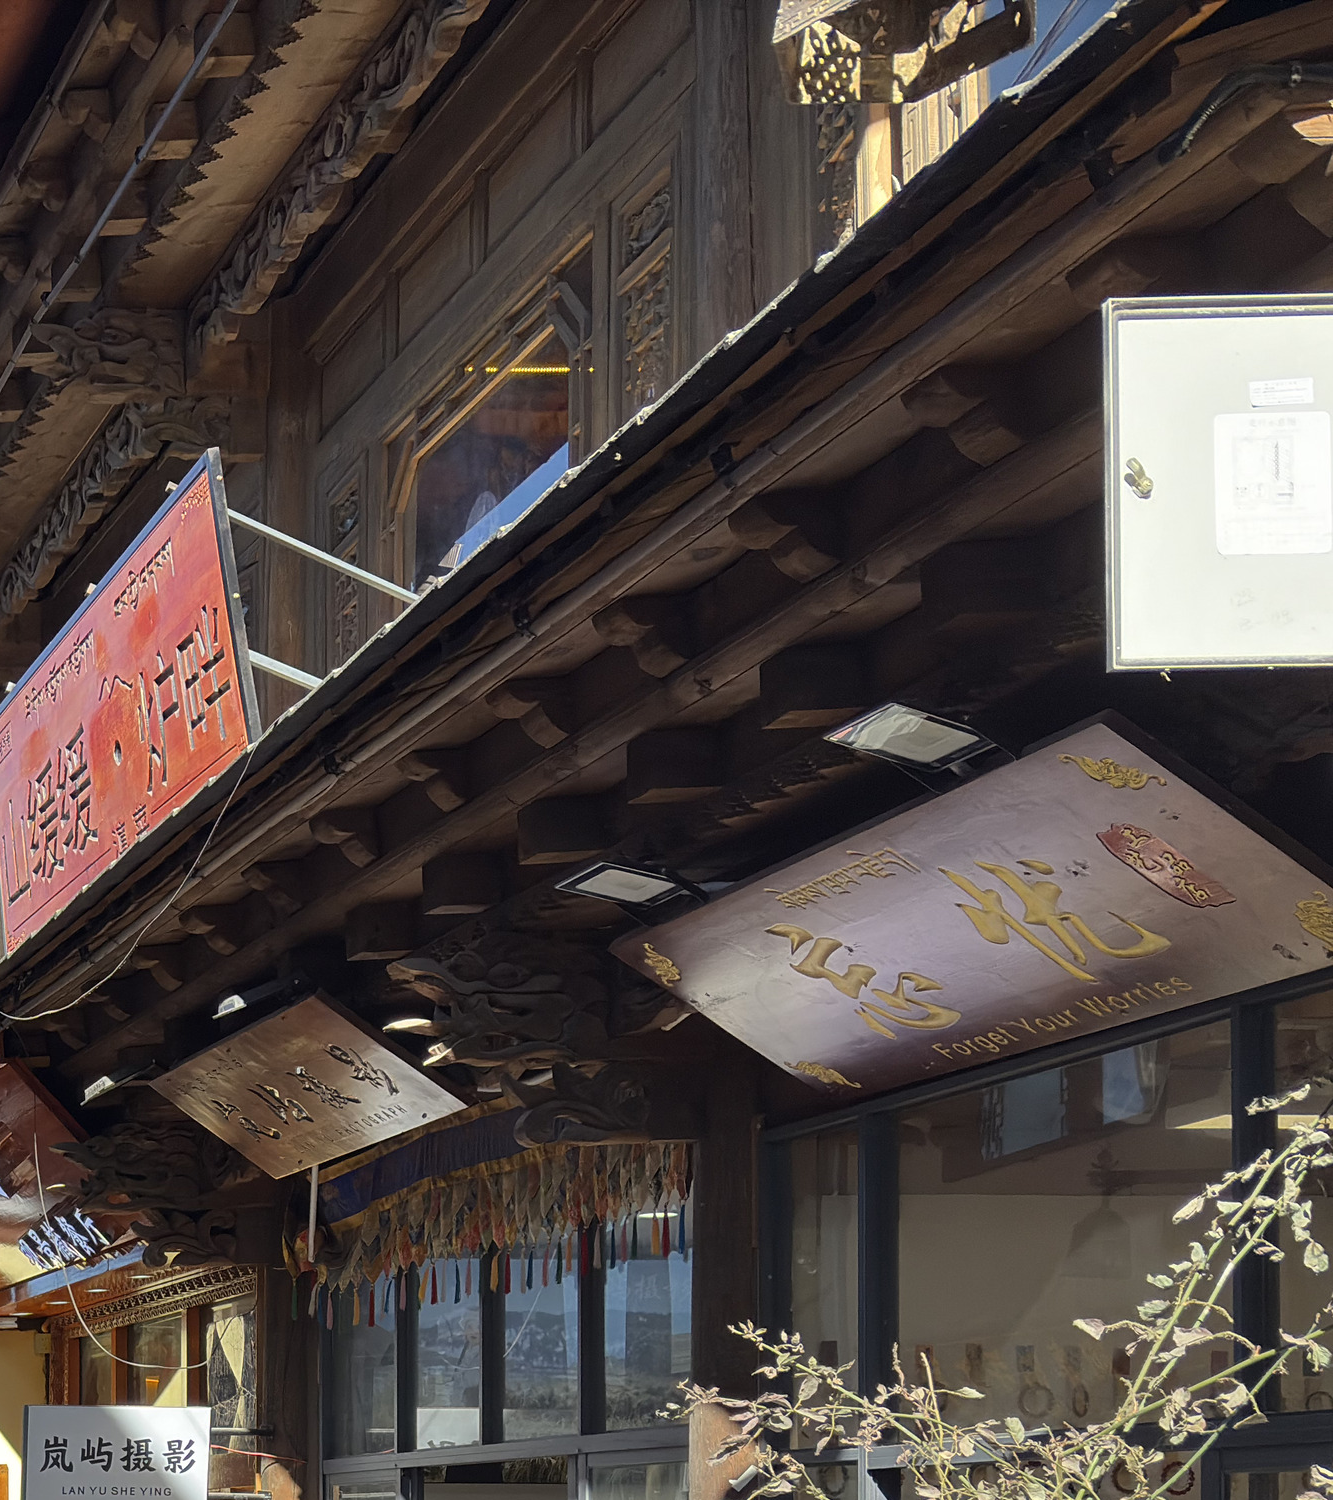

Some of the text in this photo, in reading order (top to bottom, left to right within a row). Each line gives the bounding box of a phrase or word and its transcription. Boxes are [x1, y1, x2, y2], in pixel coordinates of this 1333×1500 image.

[2, 604, 232, 906] 山缓缓 炉畔
[764, 858, 1173, 1040] 忘忧
[931, 973, 1194, 1061] Forget Your Worries
[337, 1104, 407, 1137] PHOTOGRAPH
[39, 1435, 196, 1474] 岚屿摄影
[62, 1486, 172, 1497] LAN YU SHE YING
